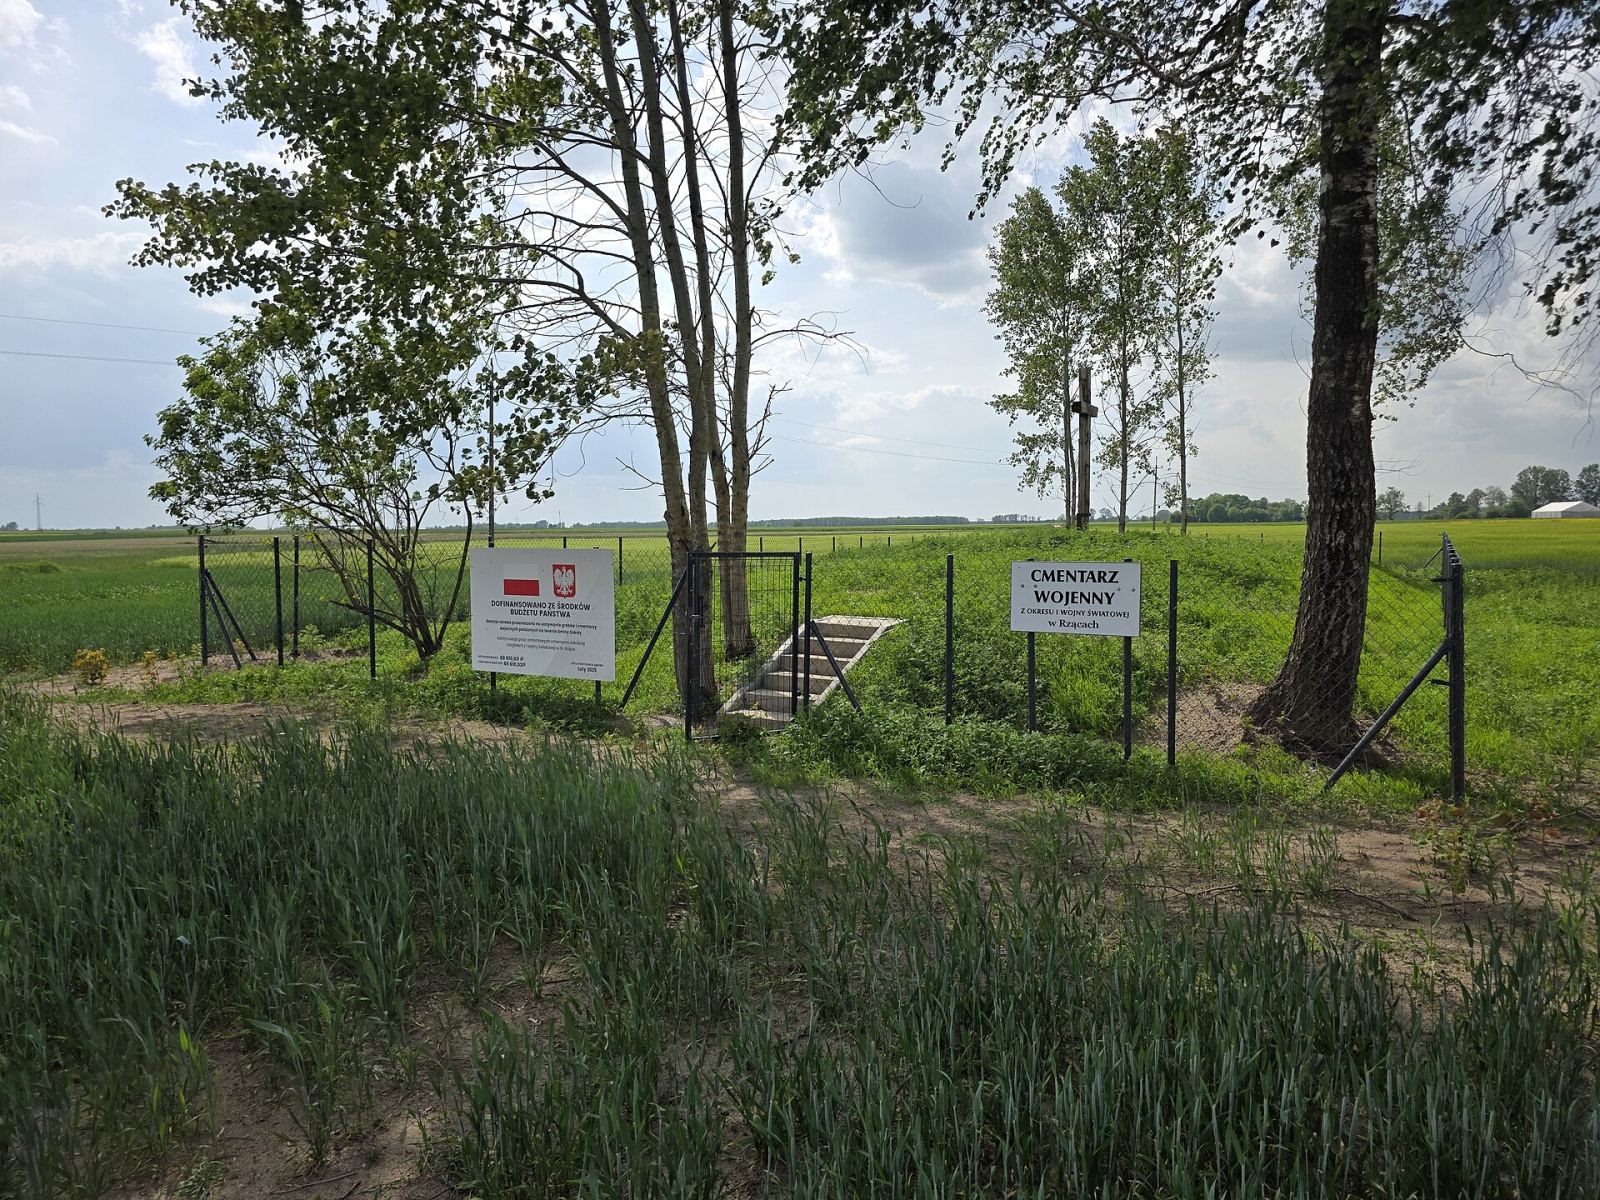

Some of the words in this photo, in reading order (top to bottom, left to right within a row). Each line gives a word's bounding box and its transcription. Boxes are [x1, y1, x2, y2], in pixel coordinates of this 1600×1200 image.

[1031, 569, 1119, 584] CMENTARZ
[1034, 590, 1115, 606] WOJENNY
[491, 600, 546, 609] DOFINANSOWANO
[557, 602, 591, 611] ŚRODKÓW
[510, 608, 538, 616] BUDŻETU
[539, 609, 571, 618] PAŃSTWA
[1060, 609, 1086, 617] WOJNY
[1087, 609, 1130, 619] ŚWIATOWEJ
[1058, 619, 1099, 630] Rzącach
